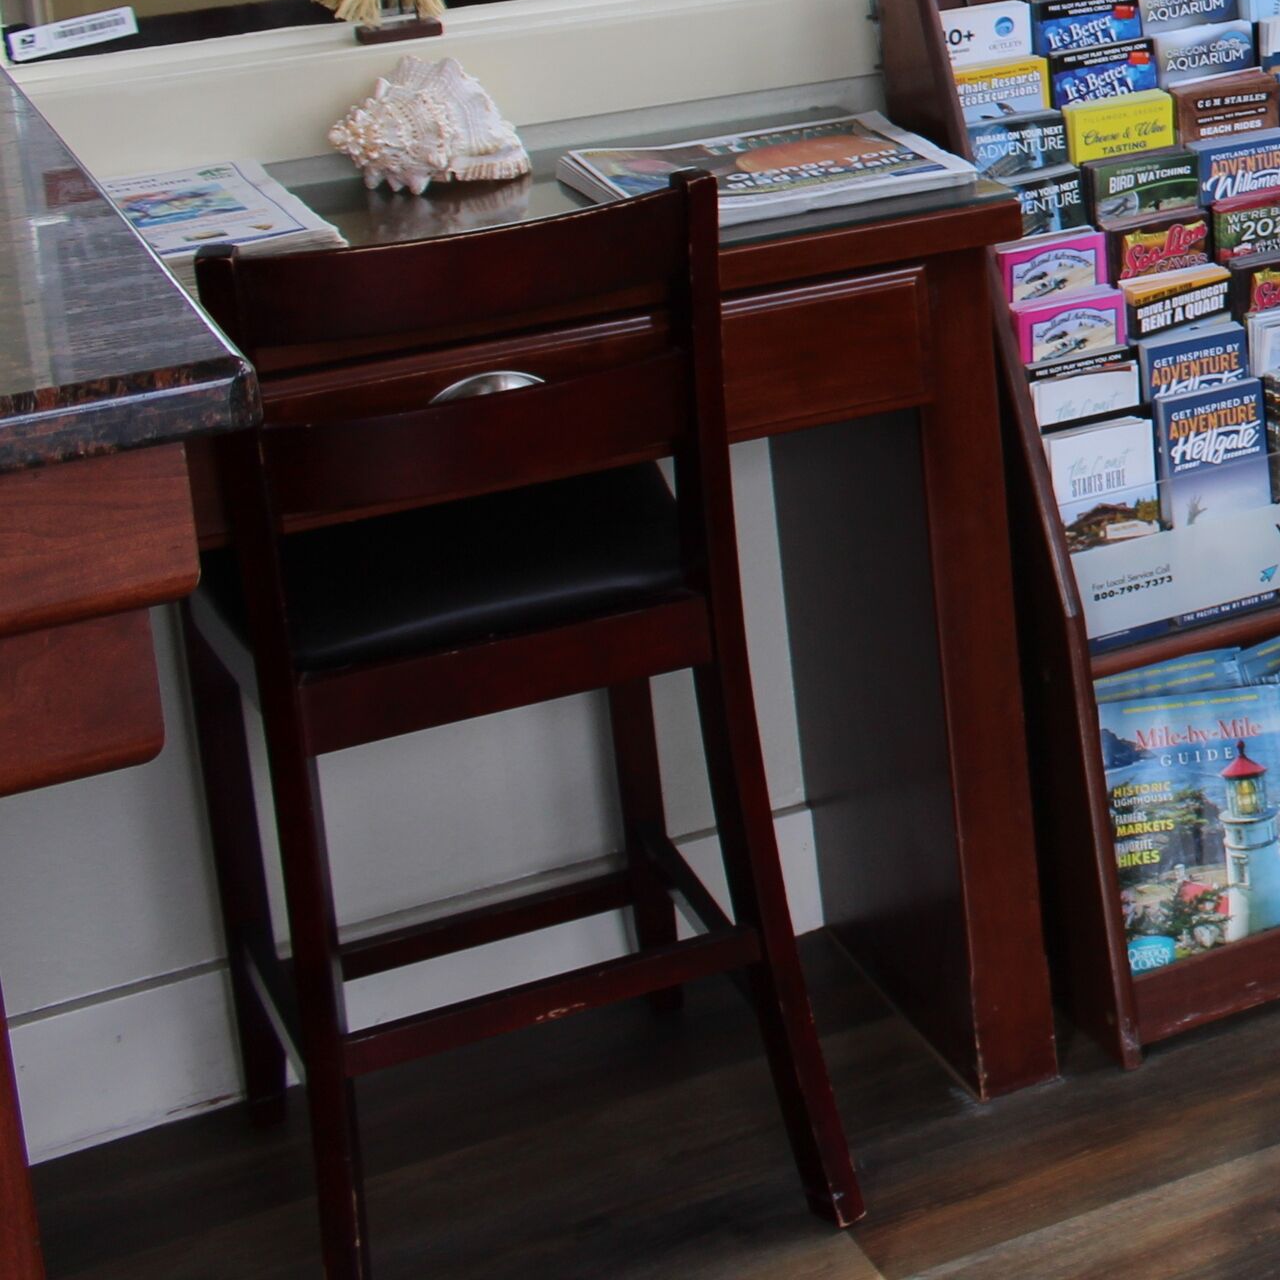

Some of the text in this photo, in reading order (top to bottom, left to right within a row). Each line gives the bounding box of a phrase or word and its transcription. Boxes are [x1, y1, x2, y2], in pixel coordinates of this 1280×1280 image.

[1049, 14, 1112, 49] It's Better
[1166, 48, 1244, 72] AQUARIUM
[957, 71, 1041, 95] Whale Research
[1064, 63, 1128, 100] It's Better
[959, 86, 1039, 107] EcoExcursions
[1200, 119, 1262, 137] BEACH RIDES
[842, 148, 899, 163] you
[977, 134, 1065, 160] ADVENTURE
[1102, 141, 1147, 155] TASTING
[1109, 165, 1191, 194] BIRD WATCHING
[1227, 210, 1267, 224] WE'RE
[1227, 224, 1241, 233] IN
[1141, 294, 1225, 333] RENT A QUAD!
[1153, 343, 1240, 369] GET INSPIRED BY
[1152, 352, 1240, 387] ADVENTURE
[1169, 402, 1257, 440] ADVENTURE
[1171, 394, 1257, 422] GET INSPIRED BY
[1171, 420, 1261, 465] Hellgate
[1072, 468, 1125, 497] STARTS HERE
[1091, 564, 1171, 592] For Local Service Call
[1093, 575, 1174, 602] 800-799-7373
[1135, 717, 1261, 751] Mile-by-Mile
[1160, 746, 1233, 767] GUIDE
[1113, 781, 1171, 798] HISTORIC
[1116, 820, 1174, 837] MARKETS
[1118, 850, 1161, 868] HIKES
